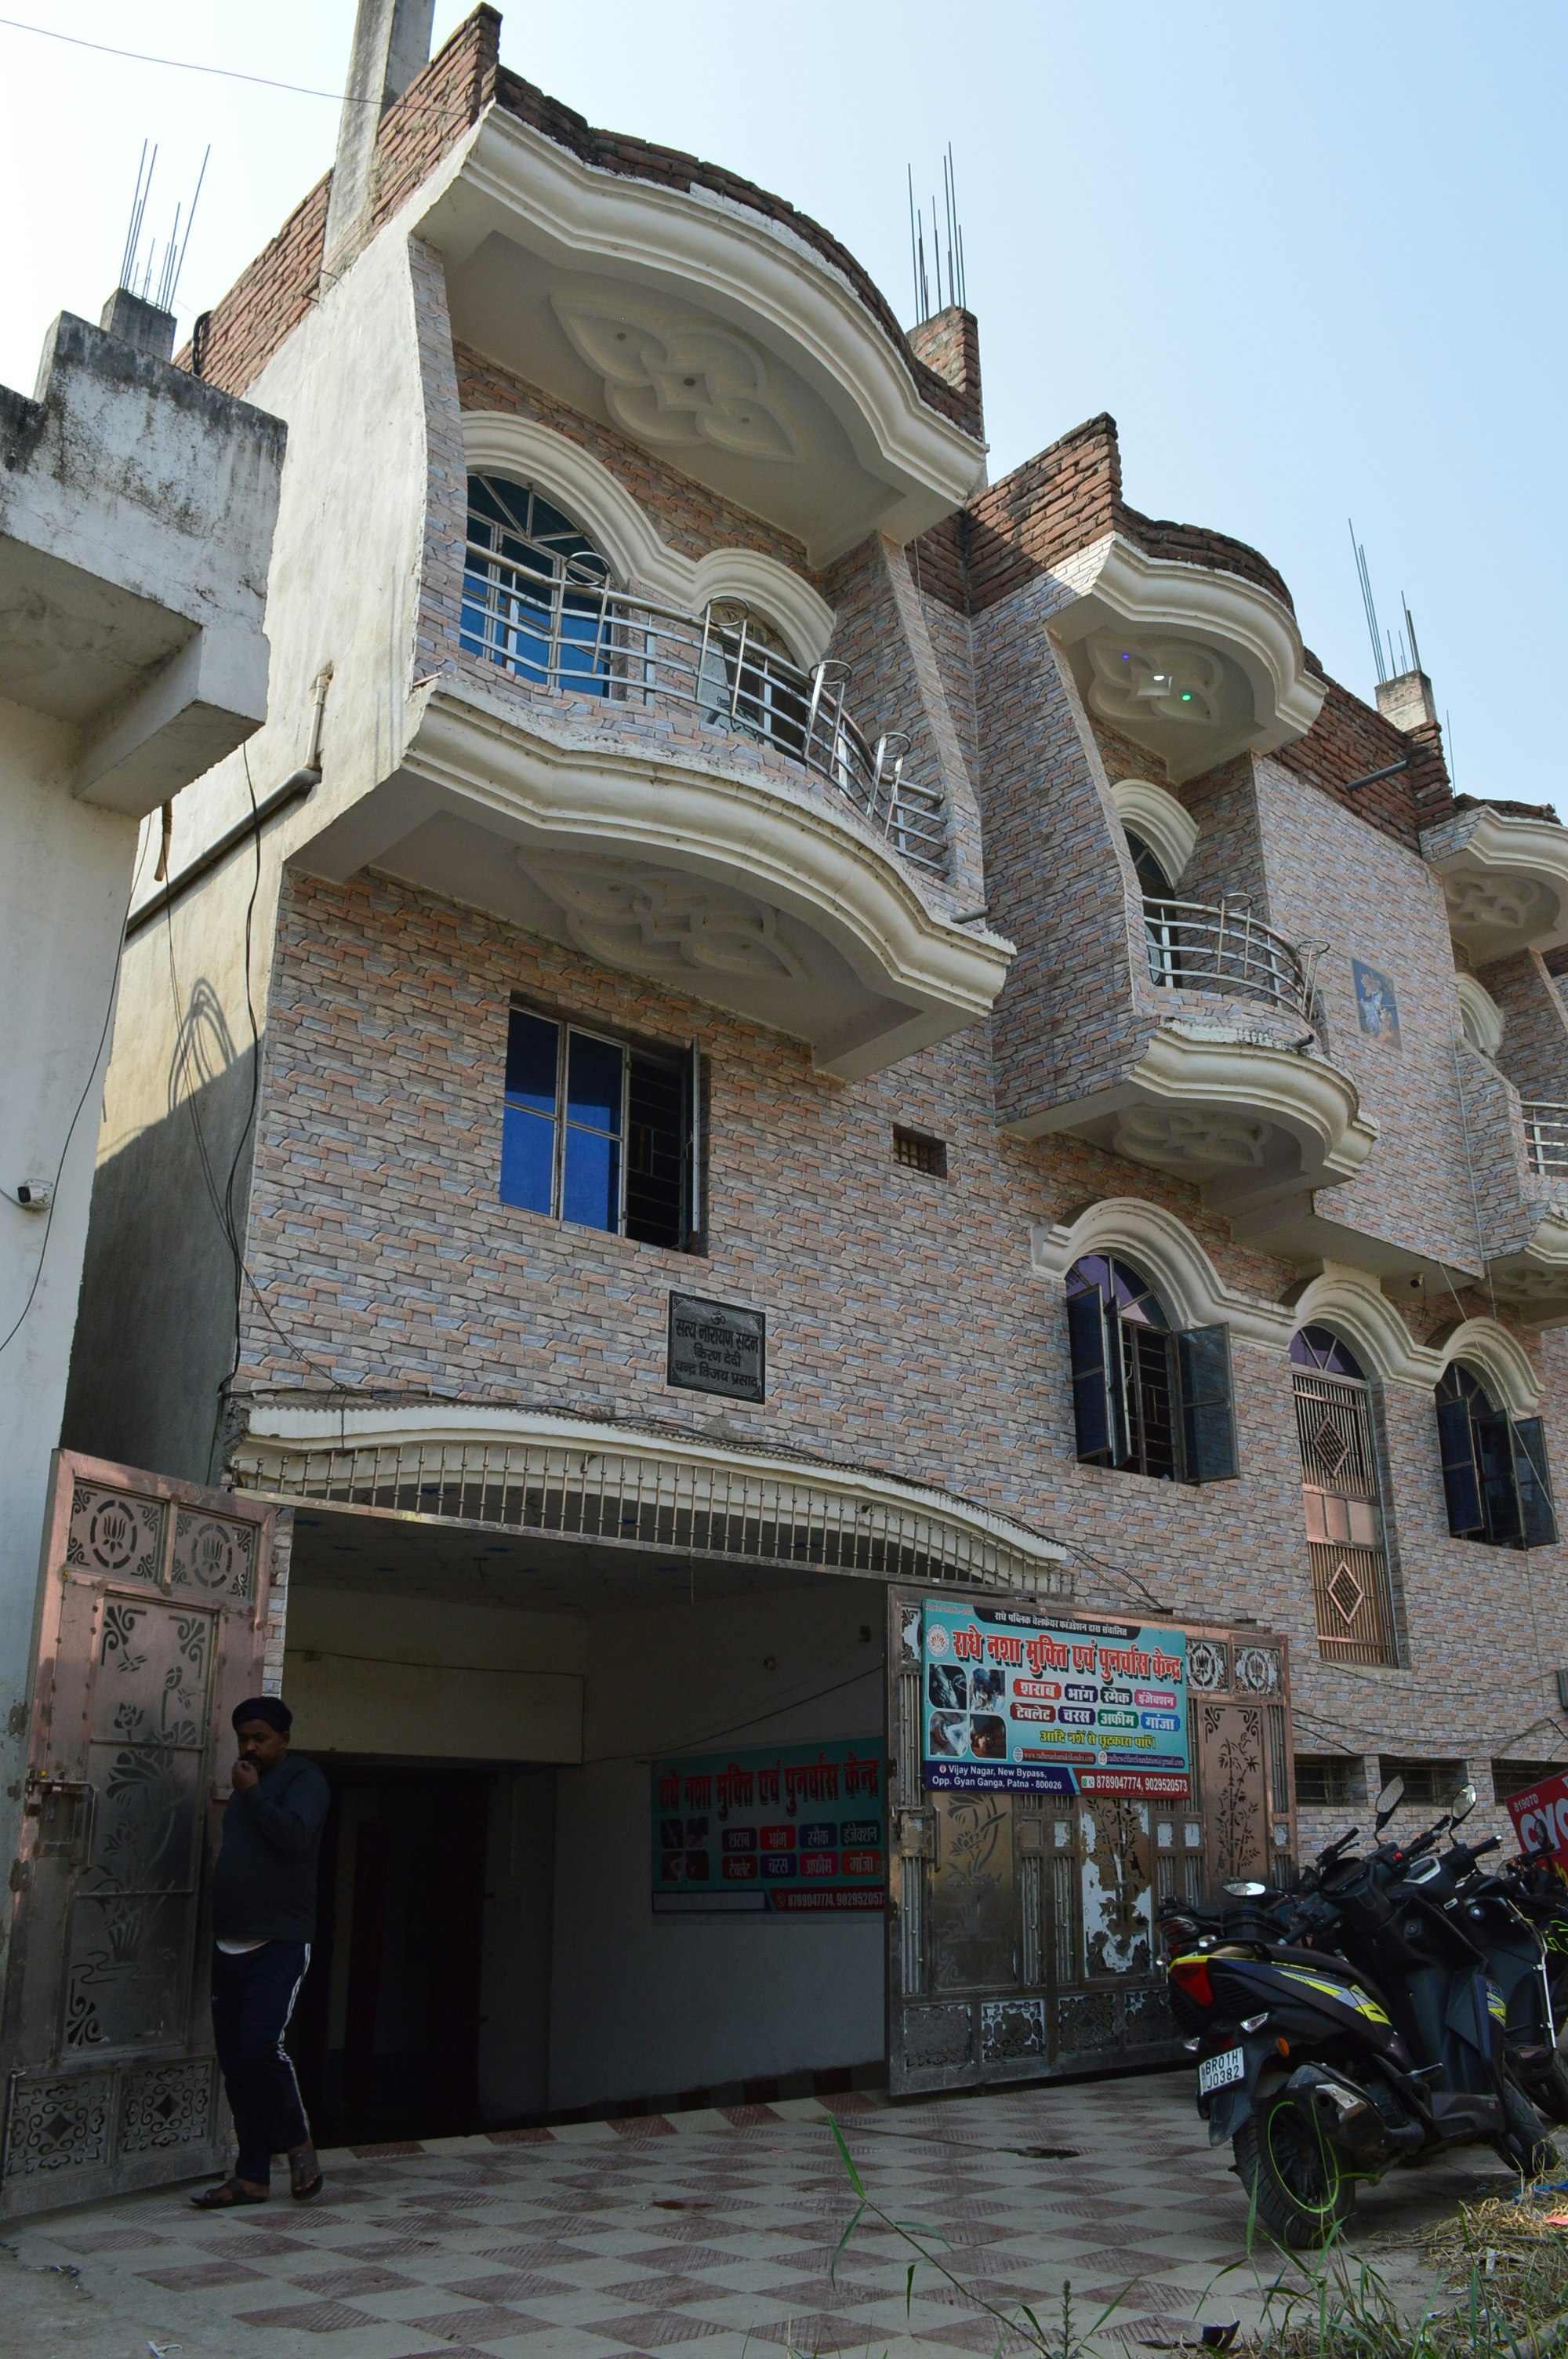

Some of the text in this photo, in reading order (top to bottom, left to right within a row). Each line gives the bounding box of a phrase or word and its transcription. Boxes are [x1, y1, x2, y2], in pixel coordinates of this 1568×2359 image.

[675, 1318, 759, 1354] सत्य नारायण सदन
[694, 1343, 741, 1367] किरण देवी
[699, 1361, 729, 1382] विजय
[731, 1372, 759, 1387] प्रसाद
[995, 1610, 1007, 1621] राधे
[1033, 1615, 1058, 1628] वेलफेयर
[952, 1623, 982, 1659] राधे
[986, 1634, 1022, 1663] नशा
[1025, 1633, 1068, 1674] मुक्ति
[1071, 1638, 1096, 1671] एवं
[1098, 1642, 1149, 1681] पुनर्वास
[1151, 1646, 1182, 1680] केन्द्र
[1020, 1681, 1056, 1697] शराब
[1068, 1685, 1094, 1702] भांग
[1138, 1691, 1174, 1707] इंजेक्शन
[1016, 1703, 1175, 1730] टेबलेट चरस अफीम गांजा
[1040, 1728, 1065, 1743] आदि
[1087, 1731, 1097, 1745] से
[932, 1776, 952, 1787] Opp.
[954, 1777, 975, 1787] Gyan
[977, 1778, 1005, 1789] Ganga,
[1007, 1779, 1029, 1788] Patna
[1036, 1781, 1062, 1790] 800026
[949, 1765, 968, 1776] Vijay
[971, 1766, 996, 1777] Nagar,
[1016, 1768, 1047, 1779] Bypass,
[1096, 1776, 1188, 1792] 8789047774, 9029520573
[659, 1750, 879, 1819] राधे नशा मुक्ति एवं पुनर्वास केन्द्र
[728, 1823, 877, 1848] शराब भांग स्मैक इंजेक्शन
[728, 1855, 873, 1877] टेबलेट चरस अफीम गांजा
[788, 1892, 884, 1907] 8789047774, 902952057
[1205, 2050, 1238, 2076] BR01H
[1207, 2065, 1240, 2089] J0382
